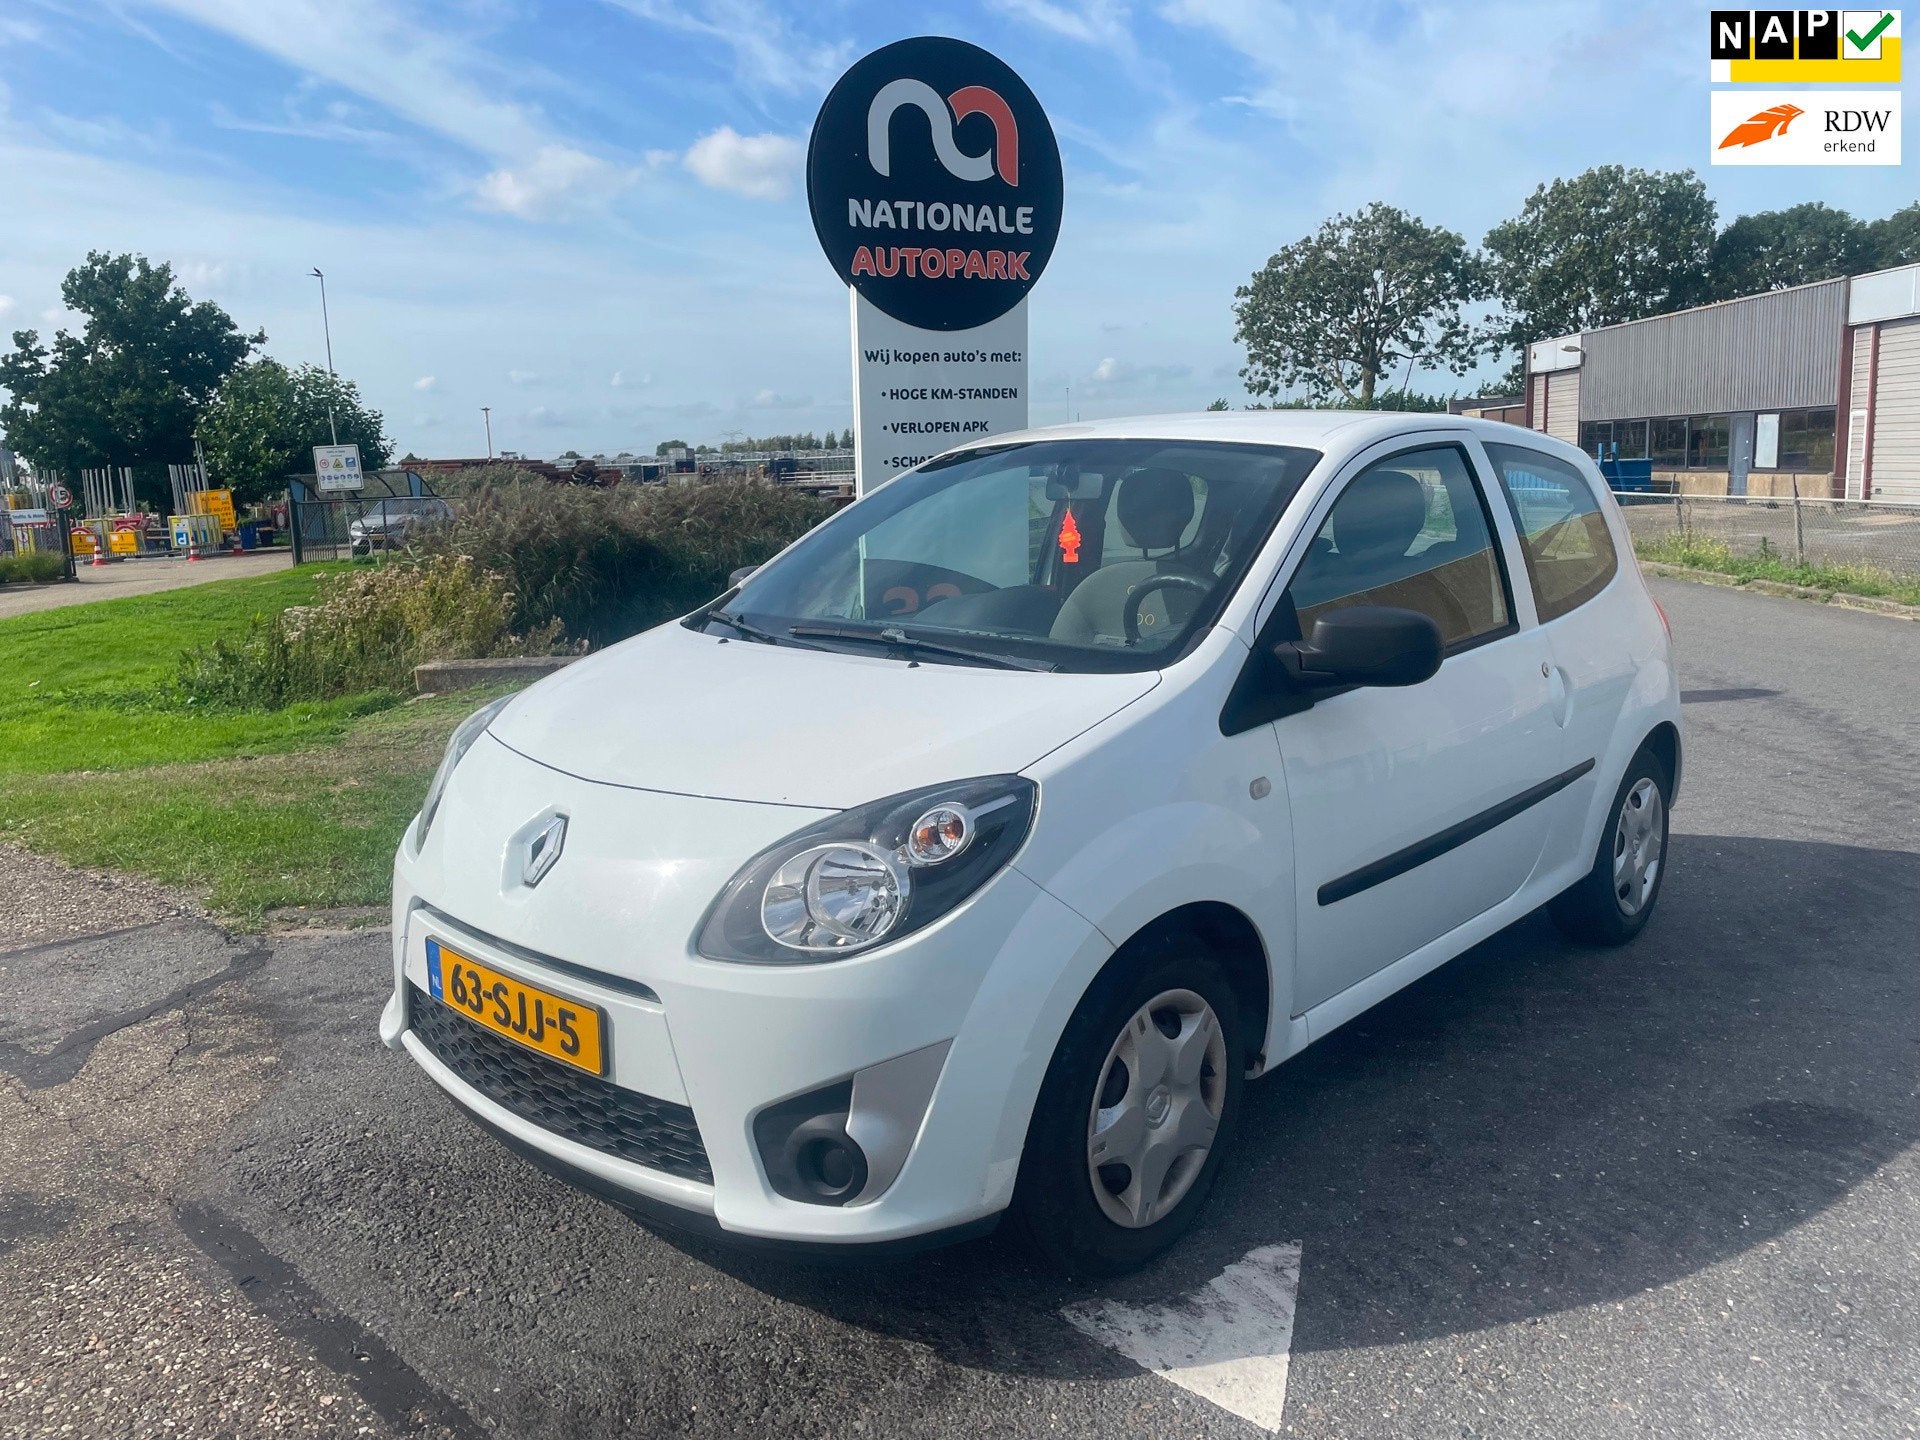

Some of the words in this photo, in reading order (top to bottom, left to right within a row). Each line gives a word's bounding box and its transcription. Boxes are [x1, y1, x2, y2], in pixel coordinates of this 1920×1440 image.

[848, 198, 1034, 235] NATIONALE
[851, 245, 1031, 281] AUTOPARK
[864, 349, 890, 366] Wij
[893, 350, 940, 365] kopen
[943, 349, 987, 363] auto's
[990, 350, 1022, 363] met:
[889, 388, 928, 400] HOGE
[930, 387, 1018, 400] KM-STANDEN
[890, 421, 960, 434] VERLOPEN
[962, 420, 989, 433] APK
[892, 455, 935, 468] SCHA
[450, 963, 580, 1057] 63-SJJ-5
